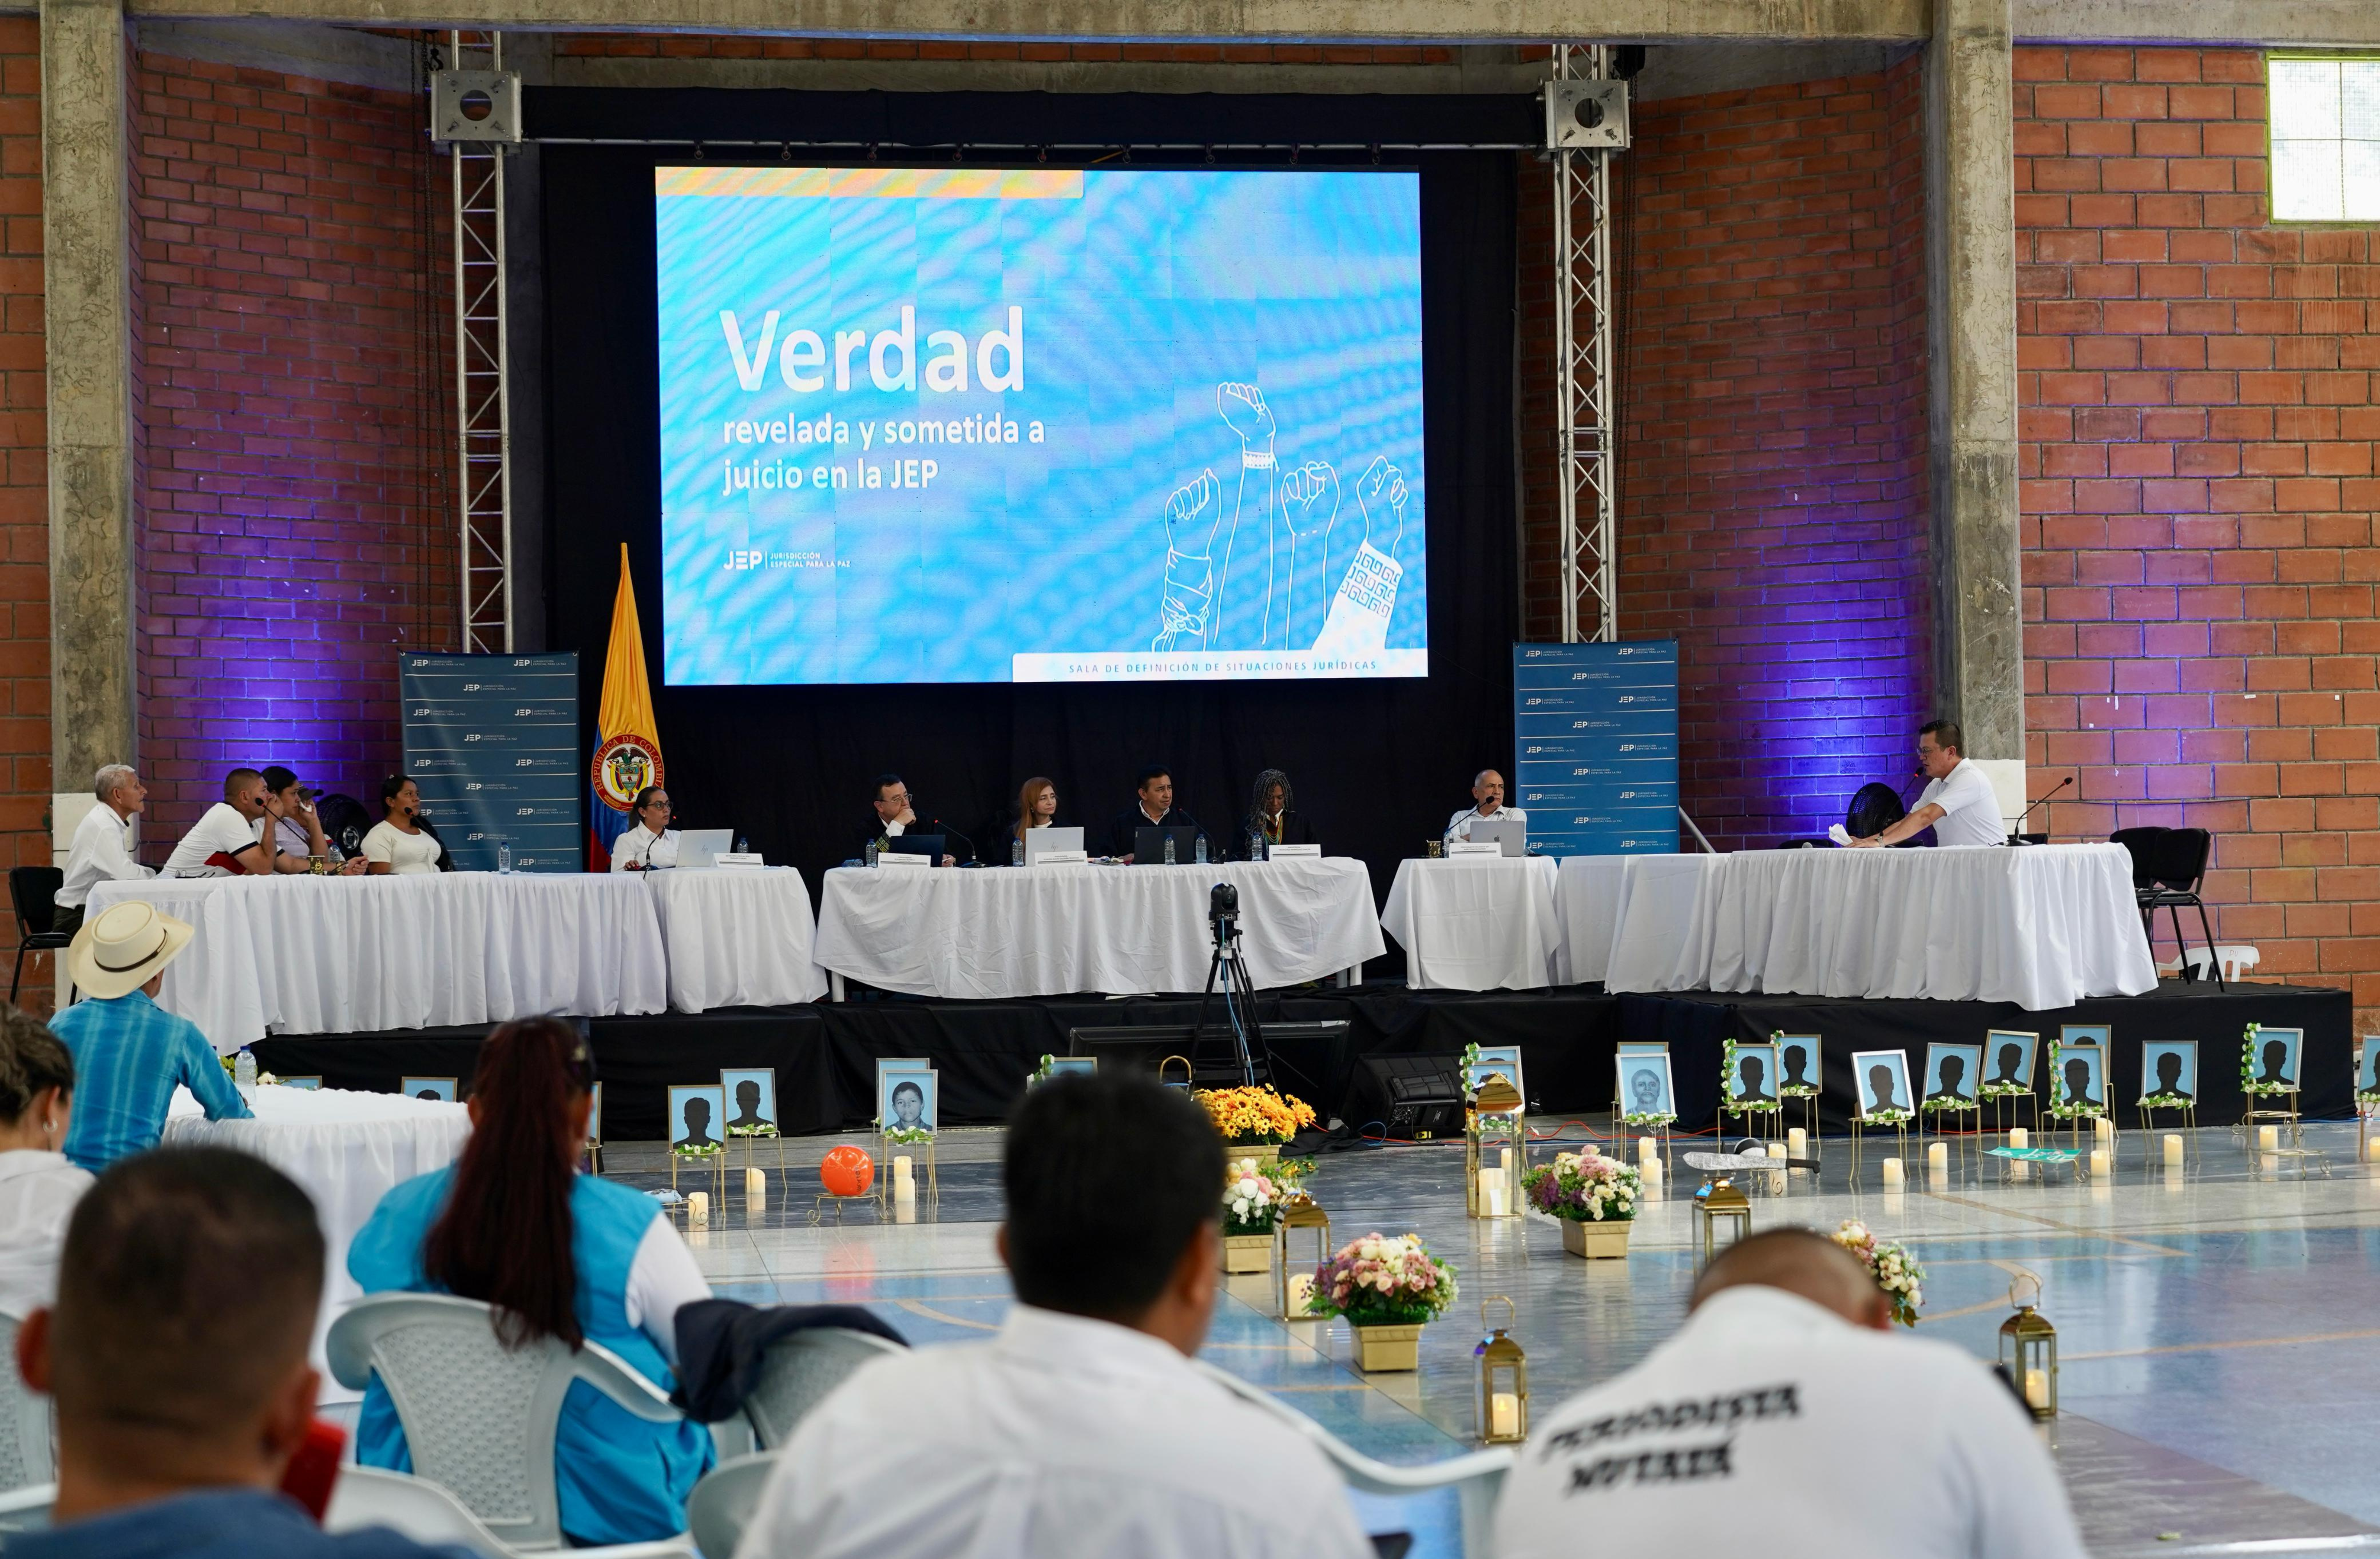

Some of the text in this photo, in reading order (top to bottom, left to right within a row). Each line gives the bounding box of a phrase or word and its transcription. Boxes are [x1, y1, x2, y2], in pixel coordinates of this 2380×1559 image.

[719, 305, 1024, 393] Verdad
[723, 412, 1045, 451] revelada y sometida a
[722, 458, 939, 496] juicio en la JEP
[723, 551, 763, 570] JEP
[1069, 659, 1376, 673] SALA DE DEFINICIÓN DE SITUACIONES JURÍDICAS
[593, 739, 620, 791] REPUBLICA
